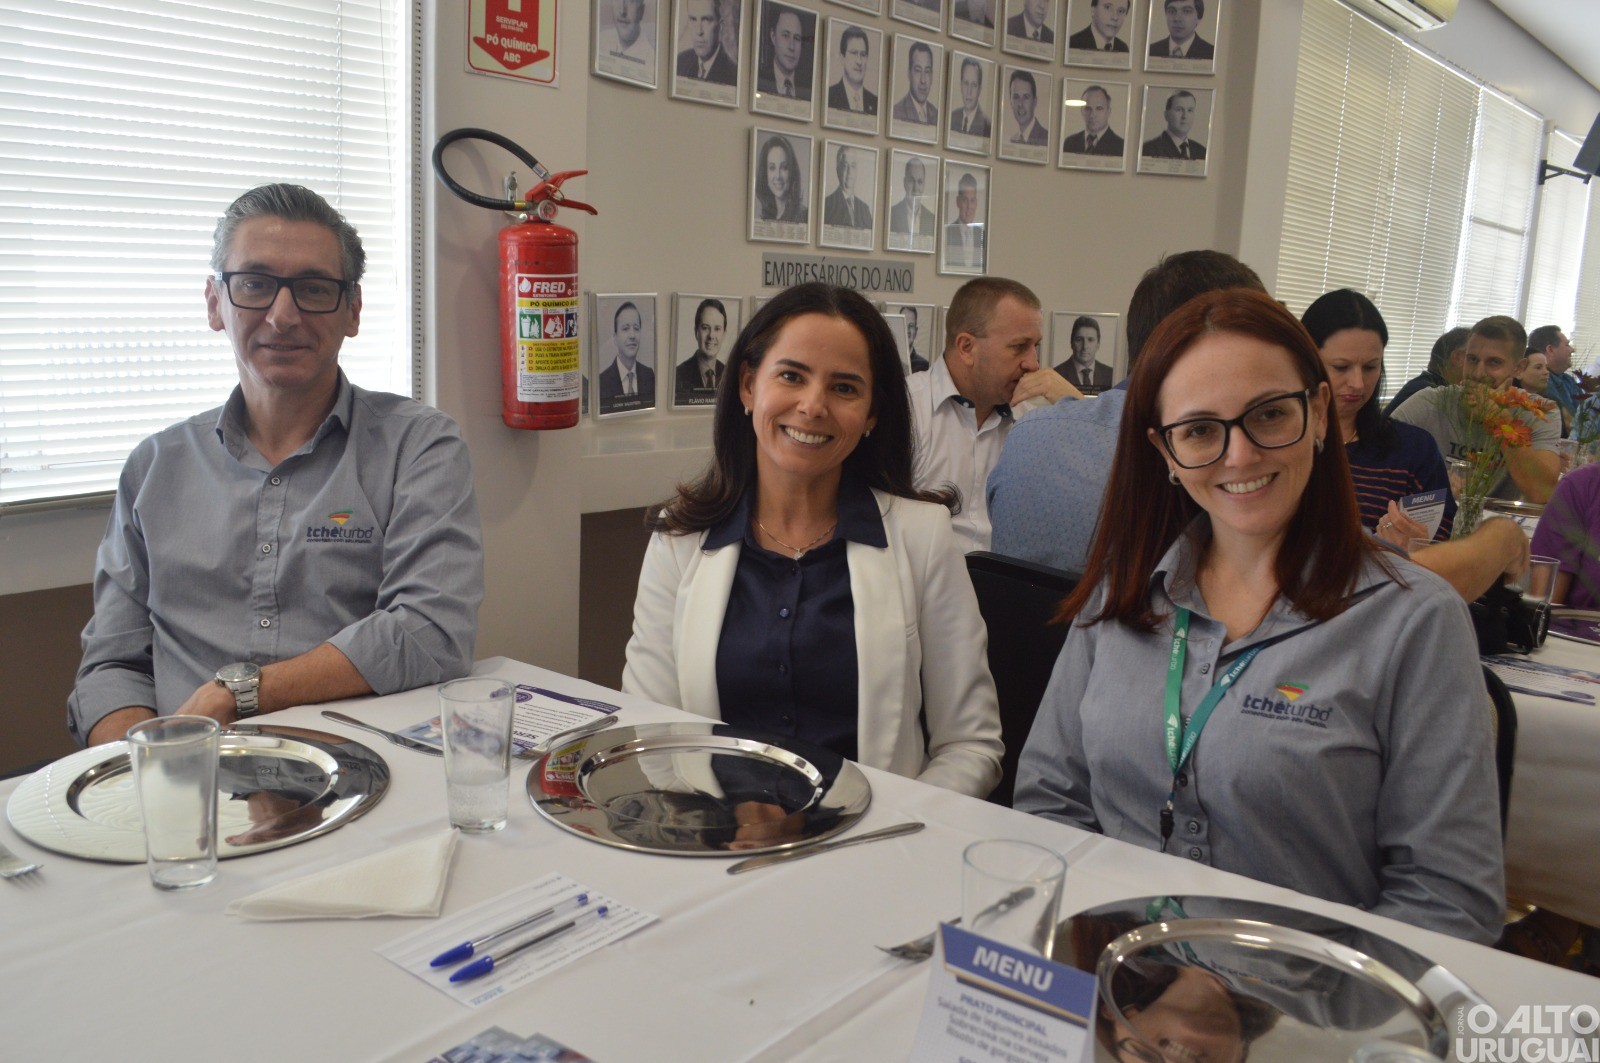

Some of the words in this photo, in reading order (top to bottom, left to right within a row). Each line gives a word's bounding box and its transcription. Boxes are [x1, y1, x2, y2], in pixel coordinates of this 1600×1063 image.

[496, 16, 528, 29] SERVIPLAN
[486, 33, 499, 45] PÓ
[501, 37, 538, 53] QUÍMICO
[503, 52, 521, 63] ABC
[764, 256, 858, 290] EMPRESÁRIOS
[861, 265, 881, 290] DO
[884, 267, 912, 291] ANO
[532, 282, 566, 293] FRED
[1412, 494, 1435, 504] MENU
[972, 945, 1053, 992] MENU
[960, 992, 994, 1014] PRATO
[995, 1007, 1048, 1037] PRINCIPAL
